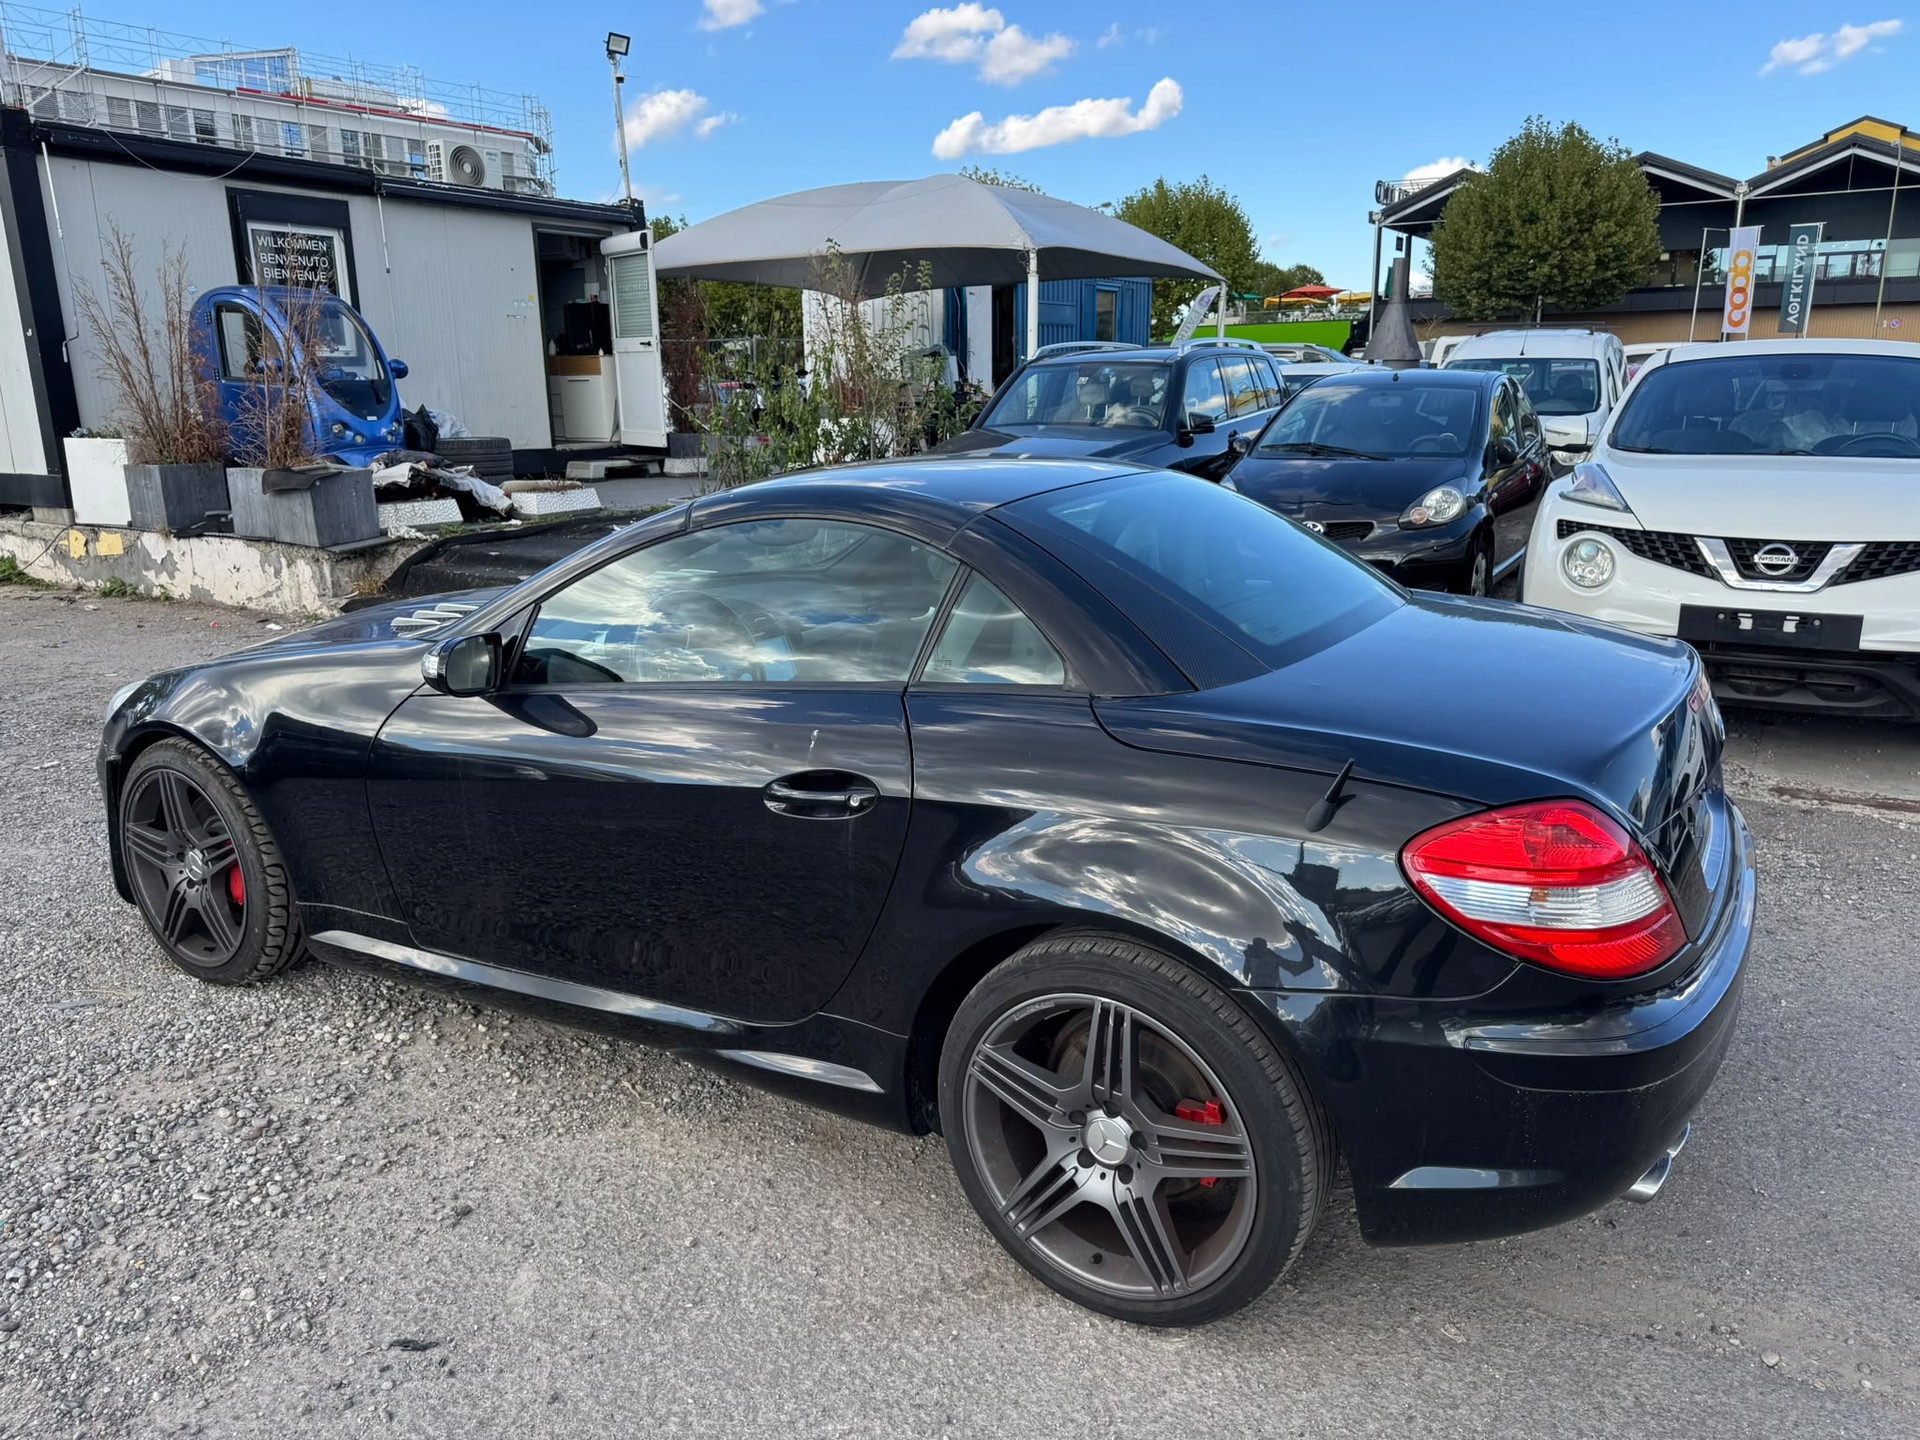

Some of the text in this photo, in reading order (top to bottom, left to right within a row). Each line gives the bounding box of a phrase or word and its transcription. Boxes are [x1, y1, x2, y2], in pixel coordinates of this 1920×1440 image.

[256, 235, 327, 251] WILKOMMEN
[260, 253, 329, 267] BENVENUTO
[1758, 555, 1794, 563] NISSAN
